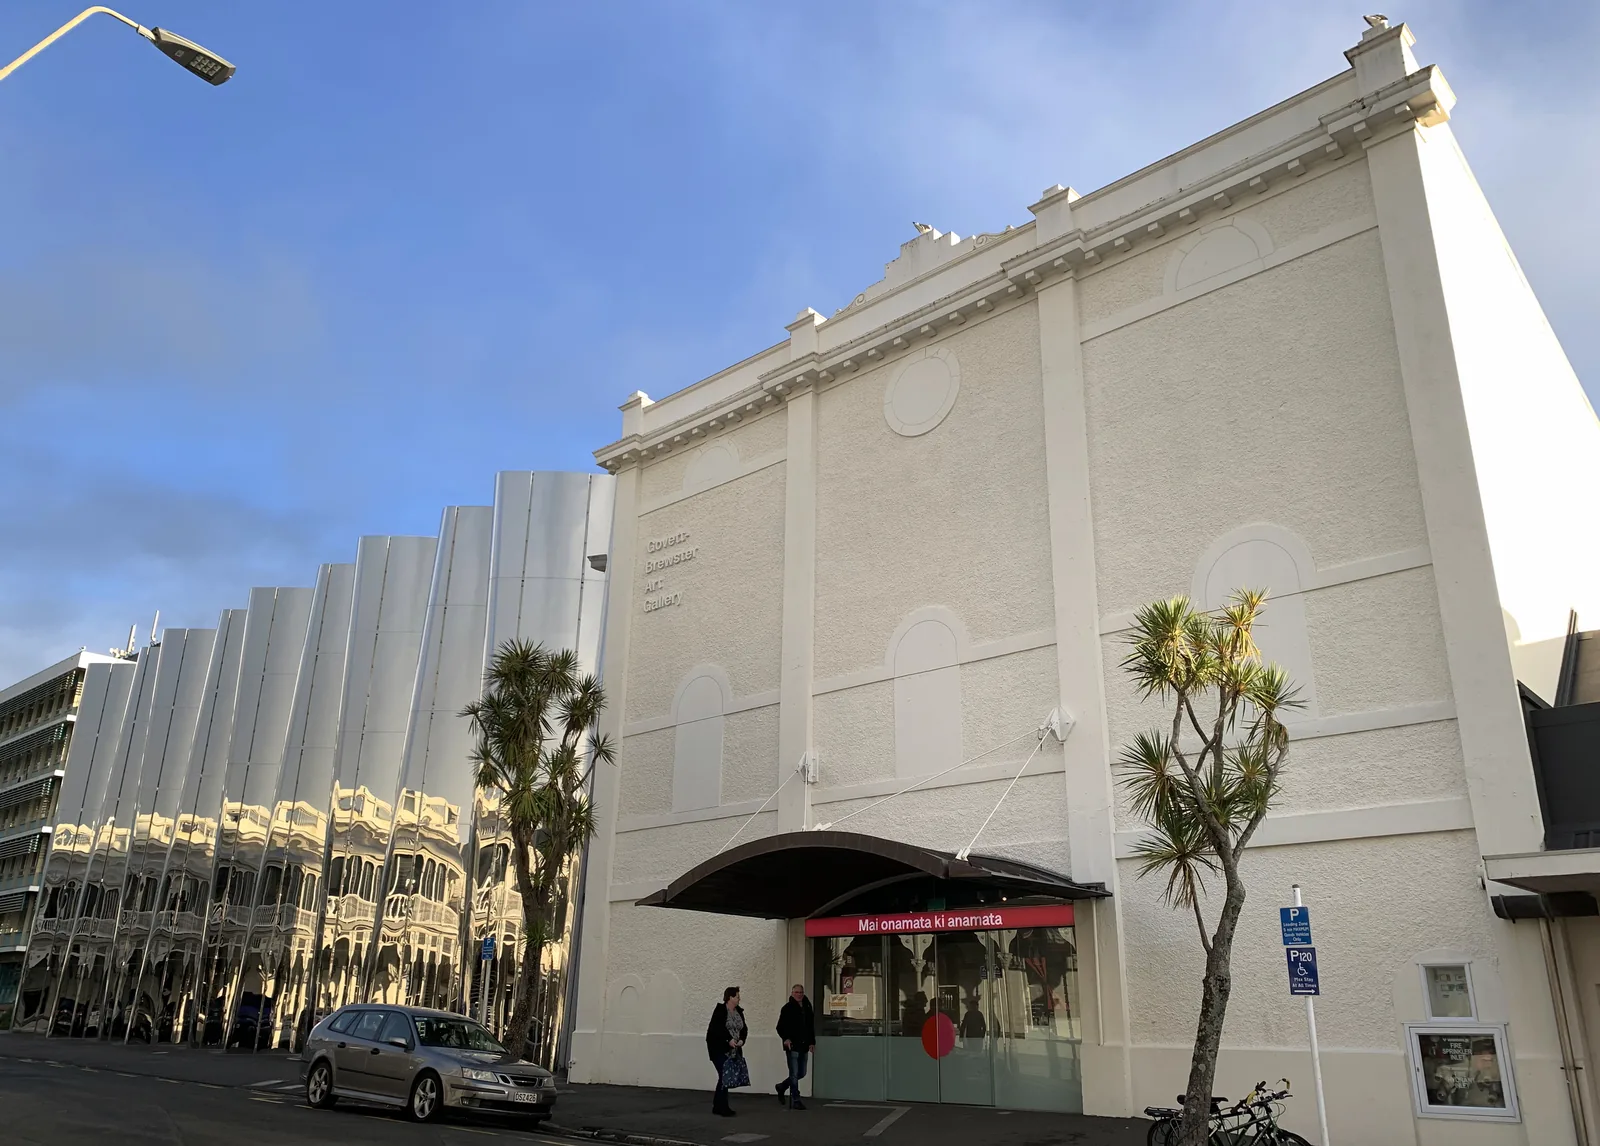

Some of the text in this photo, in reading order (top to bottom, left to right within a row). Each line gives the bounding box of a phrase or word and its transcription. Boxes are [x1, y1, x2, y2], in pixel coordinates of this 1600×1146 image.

[645, 547, 699, 574] Brewster
[644, 578, 665, 595] Art
[643, 592, 683, 613] Gallery
[858, 912, 1003, 932] Mai onamata ki anamata
[1289, 908, 1299, 921] P
[1442, 1048, 1472, 1056] SPRINKLER
